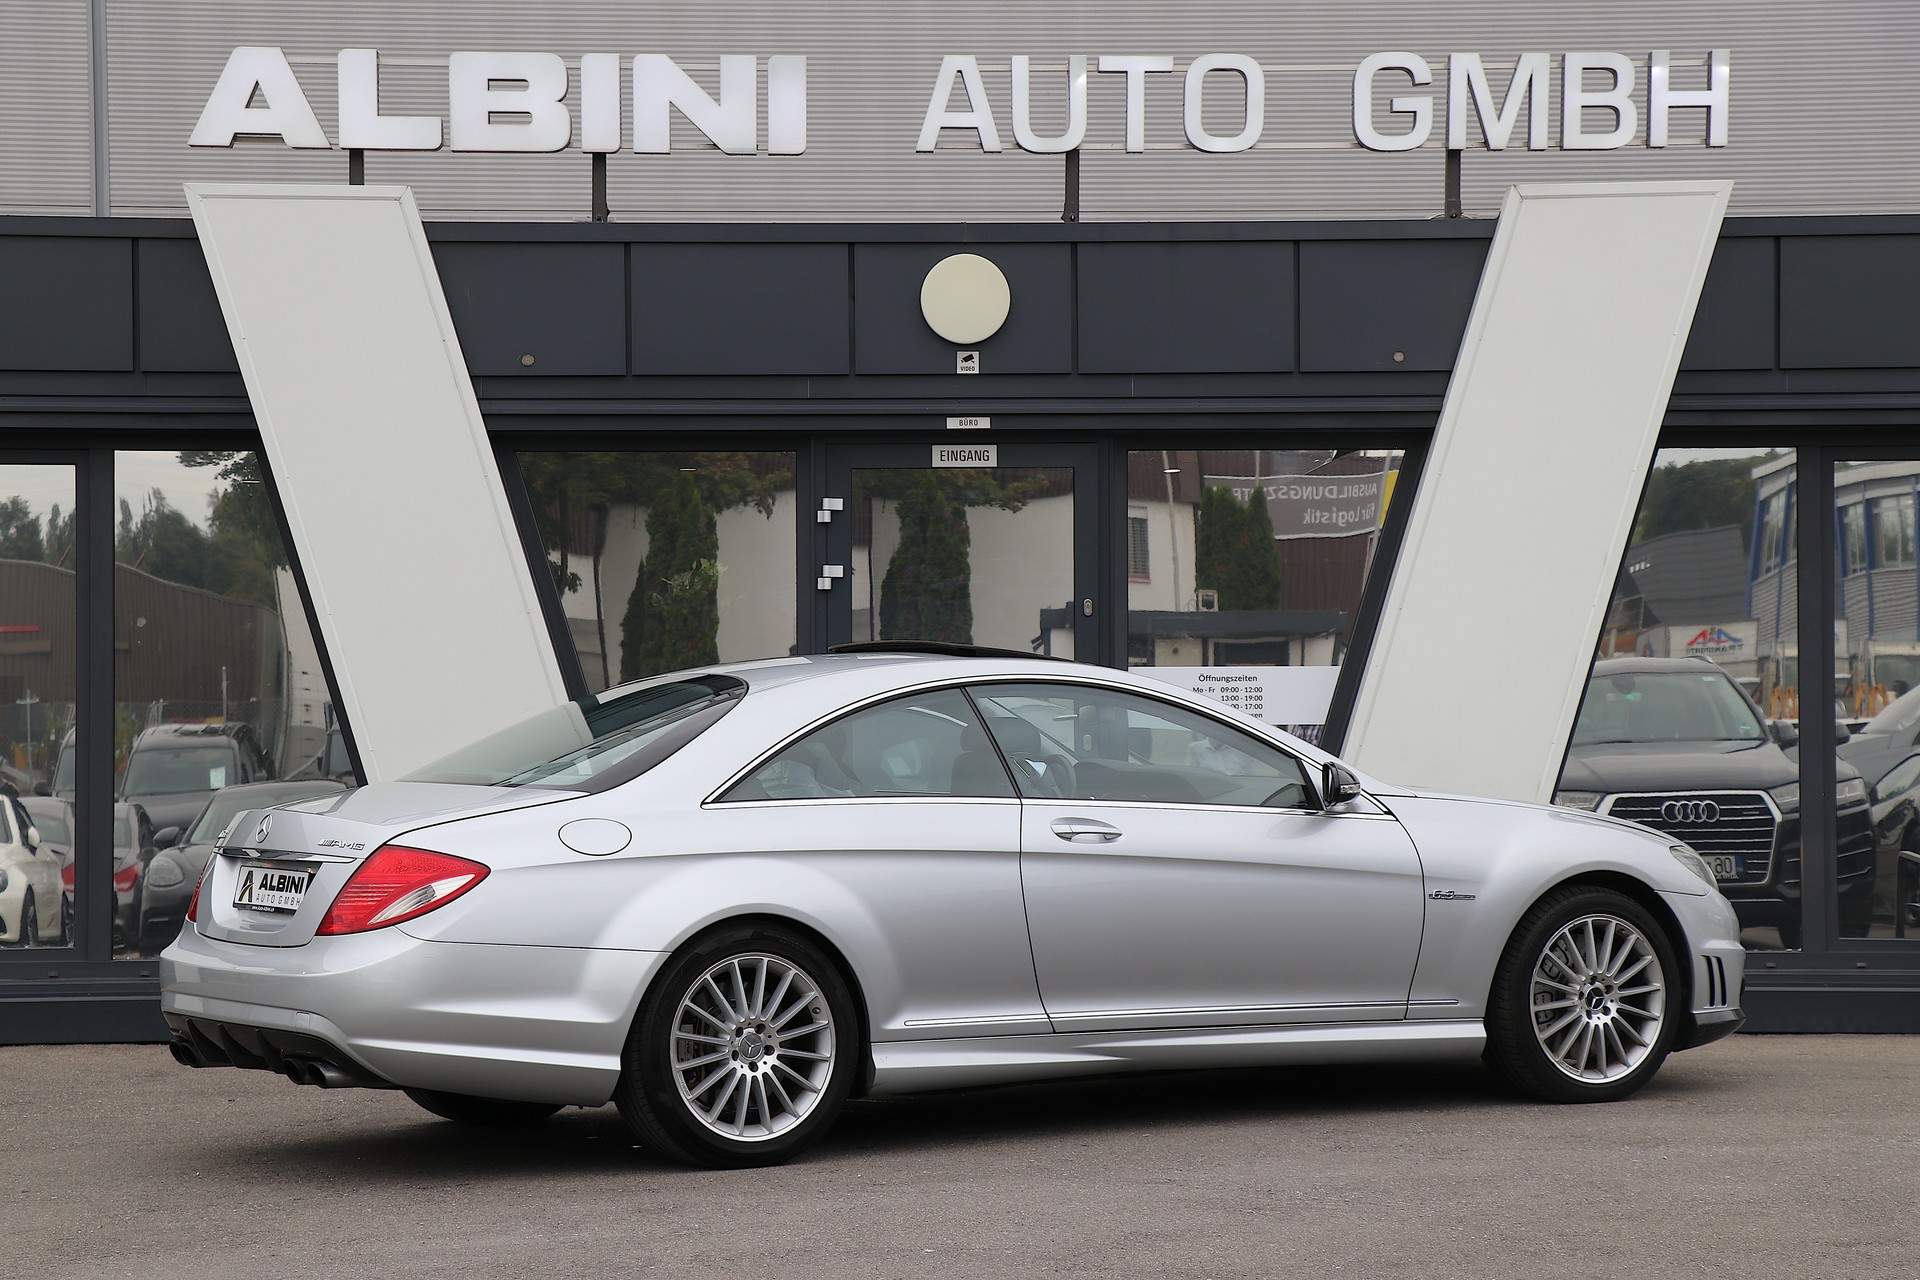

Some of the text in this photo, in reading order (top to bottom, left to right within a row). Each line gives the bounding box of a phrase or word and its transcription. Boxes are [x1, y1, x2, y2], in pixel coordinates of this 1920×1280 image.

[187, 46, 1732, 156] ALBINI AUTO GMBH
[958, 417, 979, 427] BÜRO
[939, 449, 990, 462] EINGANG
[1198, 673, 1258, 684] Öffnungszeiten
[329, 839, 365, 851] AMG
[258, 873, 305, 895] ALBINI
[256, 893, 302, 906] AUTO GMBH
